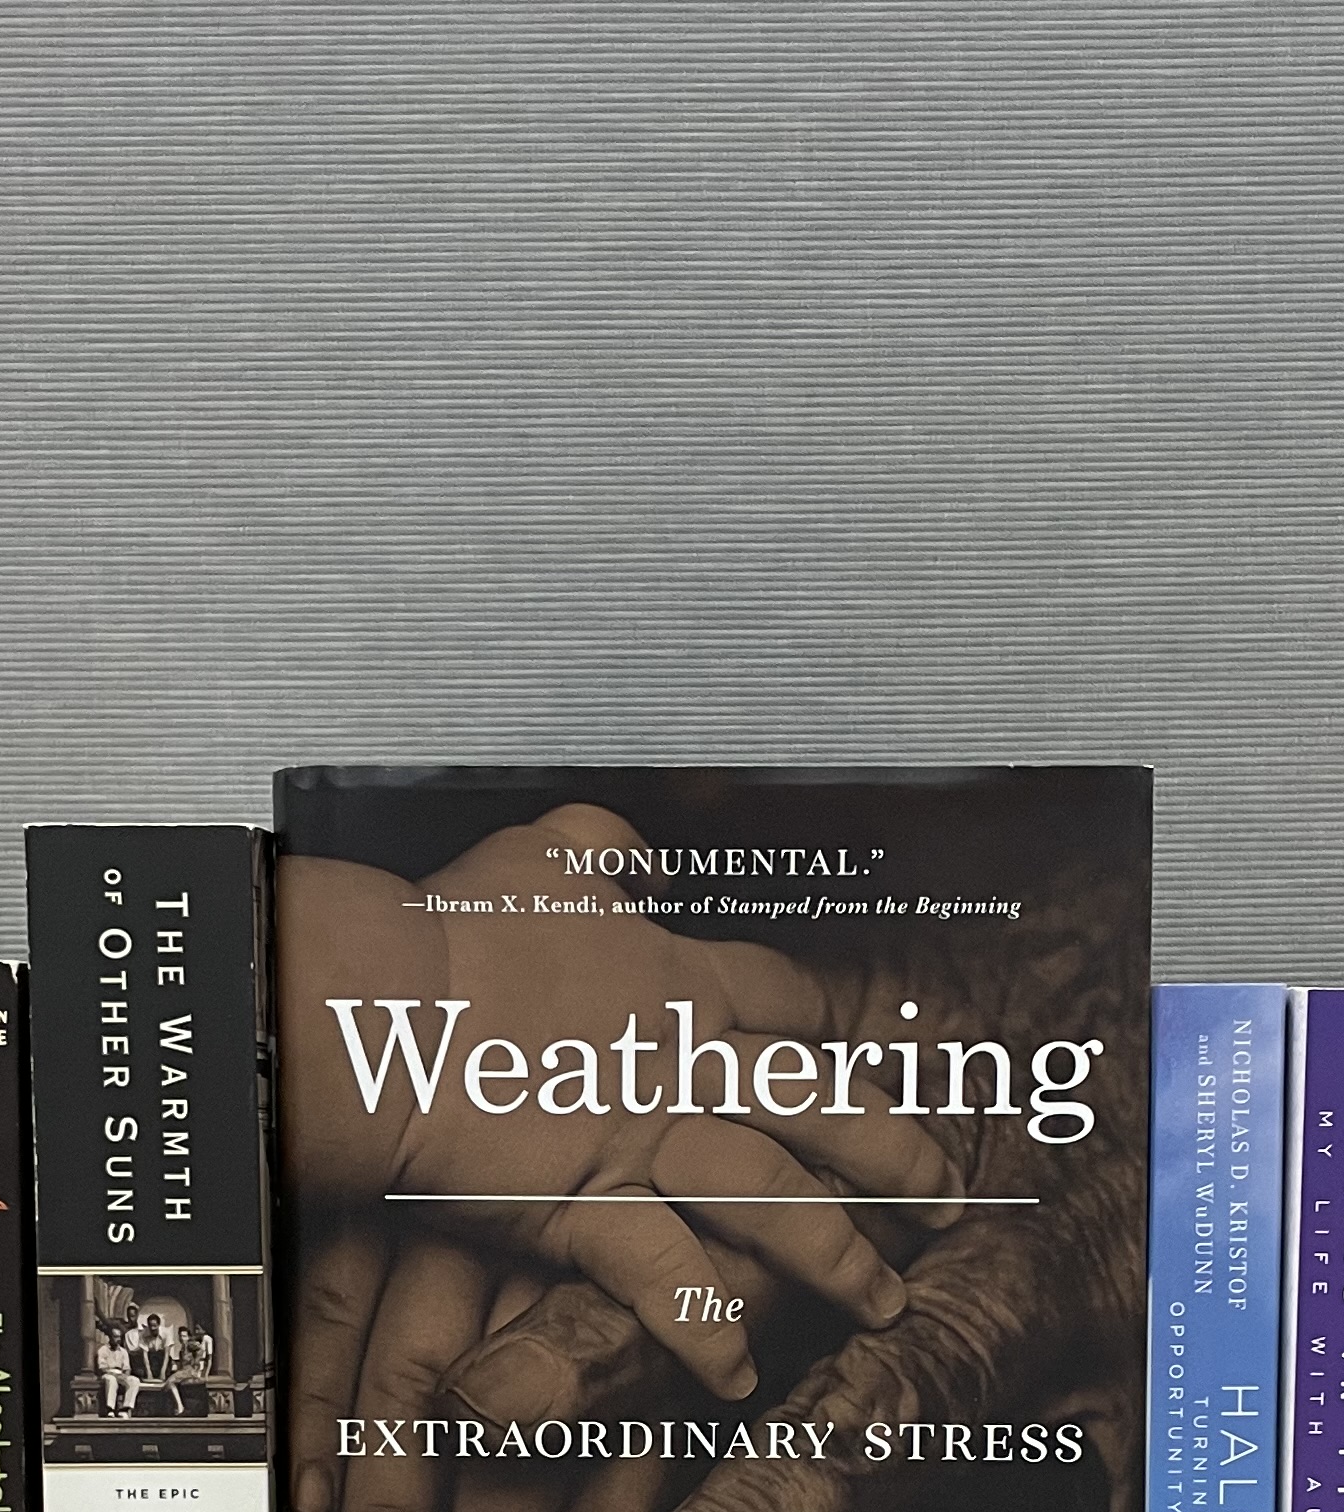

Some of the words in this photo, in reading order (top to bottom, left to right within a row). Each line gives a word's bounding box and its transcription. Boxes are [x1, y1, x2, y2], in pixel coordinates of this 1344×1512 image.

[103, 868, 123, 905] OF
[155, 892, 189, 986] THE
[501, 896, 526, 914] X.
[533, 894, 606, 918] Kendi,
[611, 896, 684, 916] author
[690, 895, 714, 916] of
[716, 895, 829, 920] Stamped
[826, 895, 870, 922] from
[875, 897, 908, 916] the
[914, 896, 1022, 921] Beginning
[98, 927, 132, 1088] OTHER
[159, 1014, 193, 1221] WARMTH
[325, 998, 1105, 1145] Weathering
[104, 1116, 138, 1244] SUNS
[336, 1419, 836, 1462] EXTRAORDINARY
[863, 1423, 1085, 1464] STRESS
